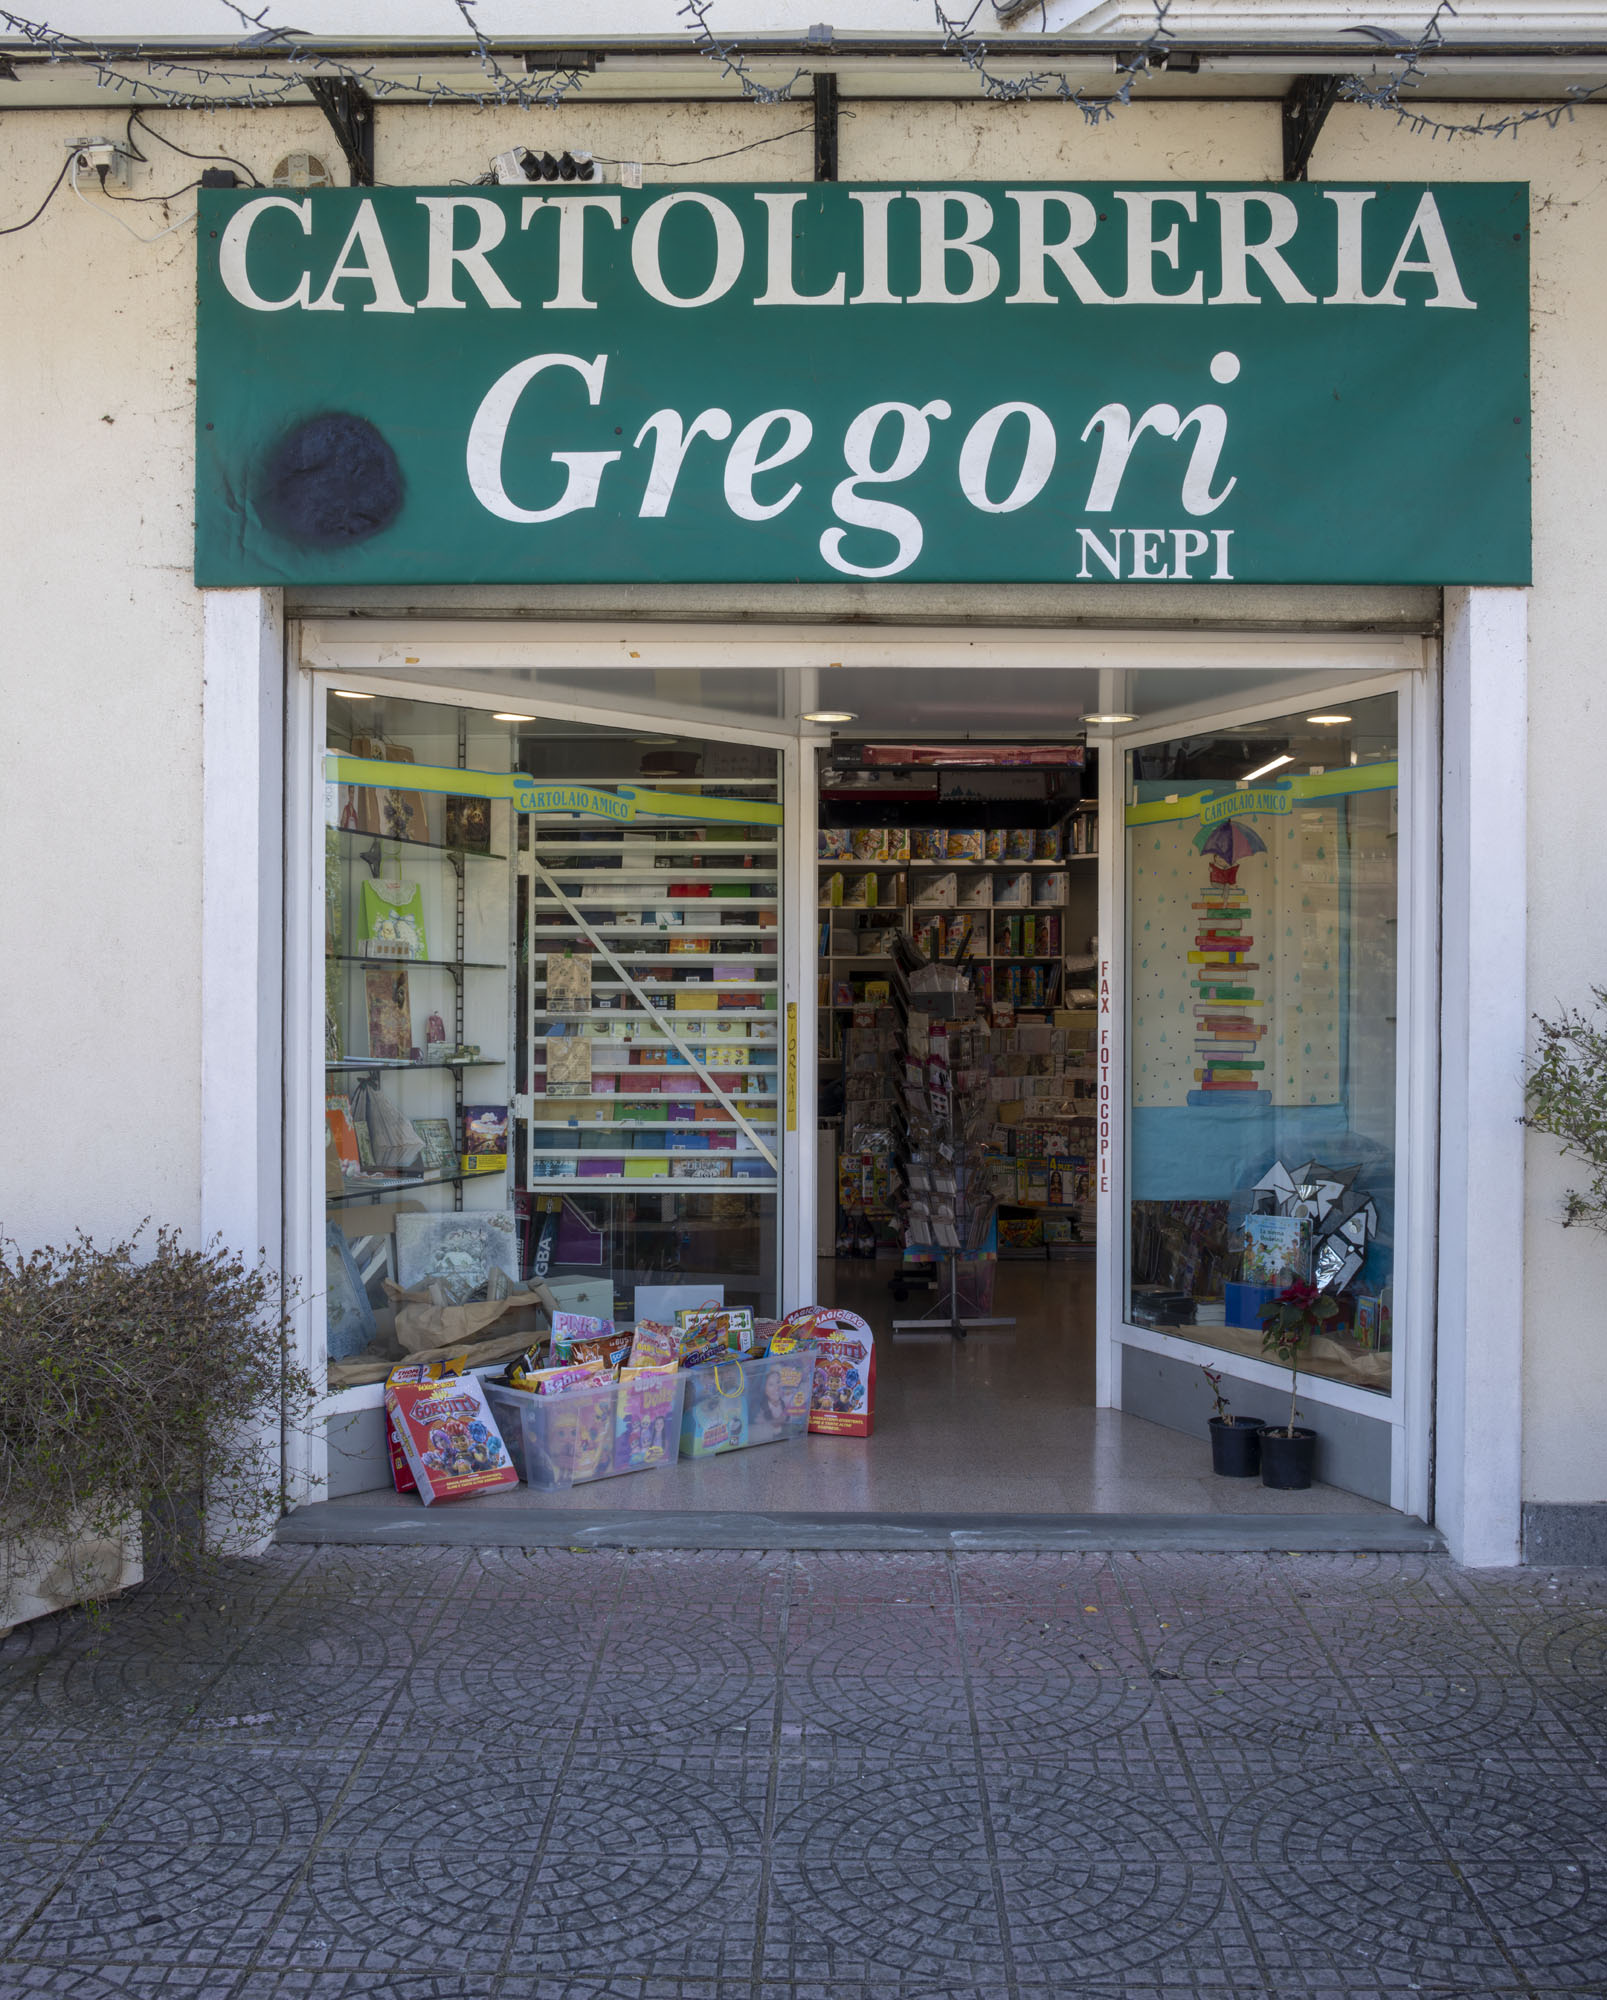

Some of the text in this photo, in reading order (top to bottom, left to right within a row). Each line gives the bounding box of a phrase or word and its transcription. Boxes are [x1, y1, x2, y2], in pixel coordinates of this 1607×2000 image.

[219, 190, 1478, 314] CARTOLIBRERIA
[466, 351, 1241, 578] Gregori
[1076, 528, 1235, 580] NEPI
[520, 791, 628, 818] CARTOLAIO AMICO
[1204, 794, 1286, 822] CARTOLAIO AMICO
[1100, 961, 1109, 1013] FAX
[1100, 1030, 1109, 1192] FOTOCOPIE
[535, 1237, 552, 1279] GBA
[845, 1313, 864, 1328] BAG
[817, 1342, 863, 1360] ORMITI
[415, 1398, 477, 1419] GORMITI
